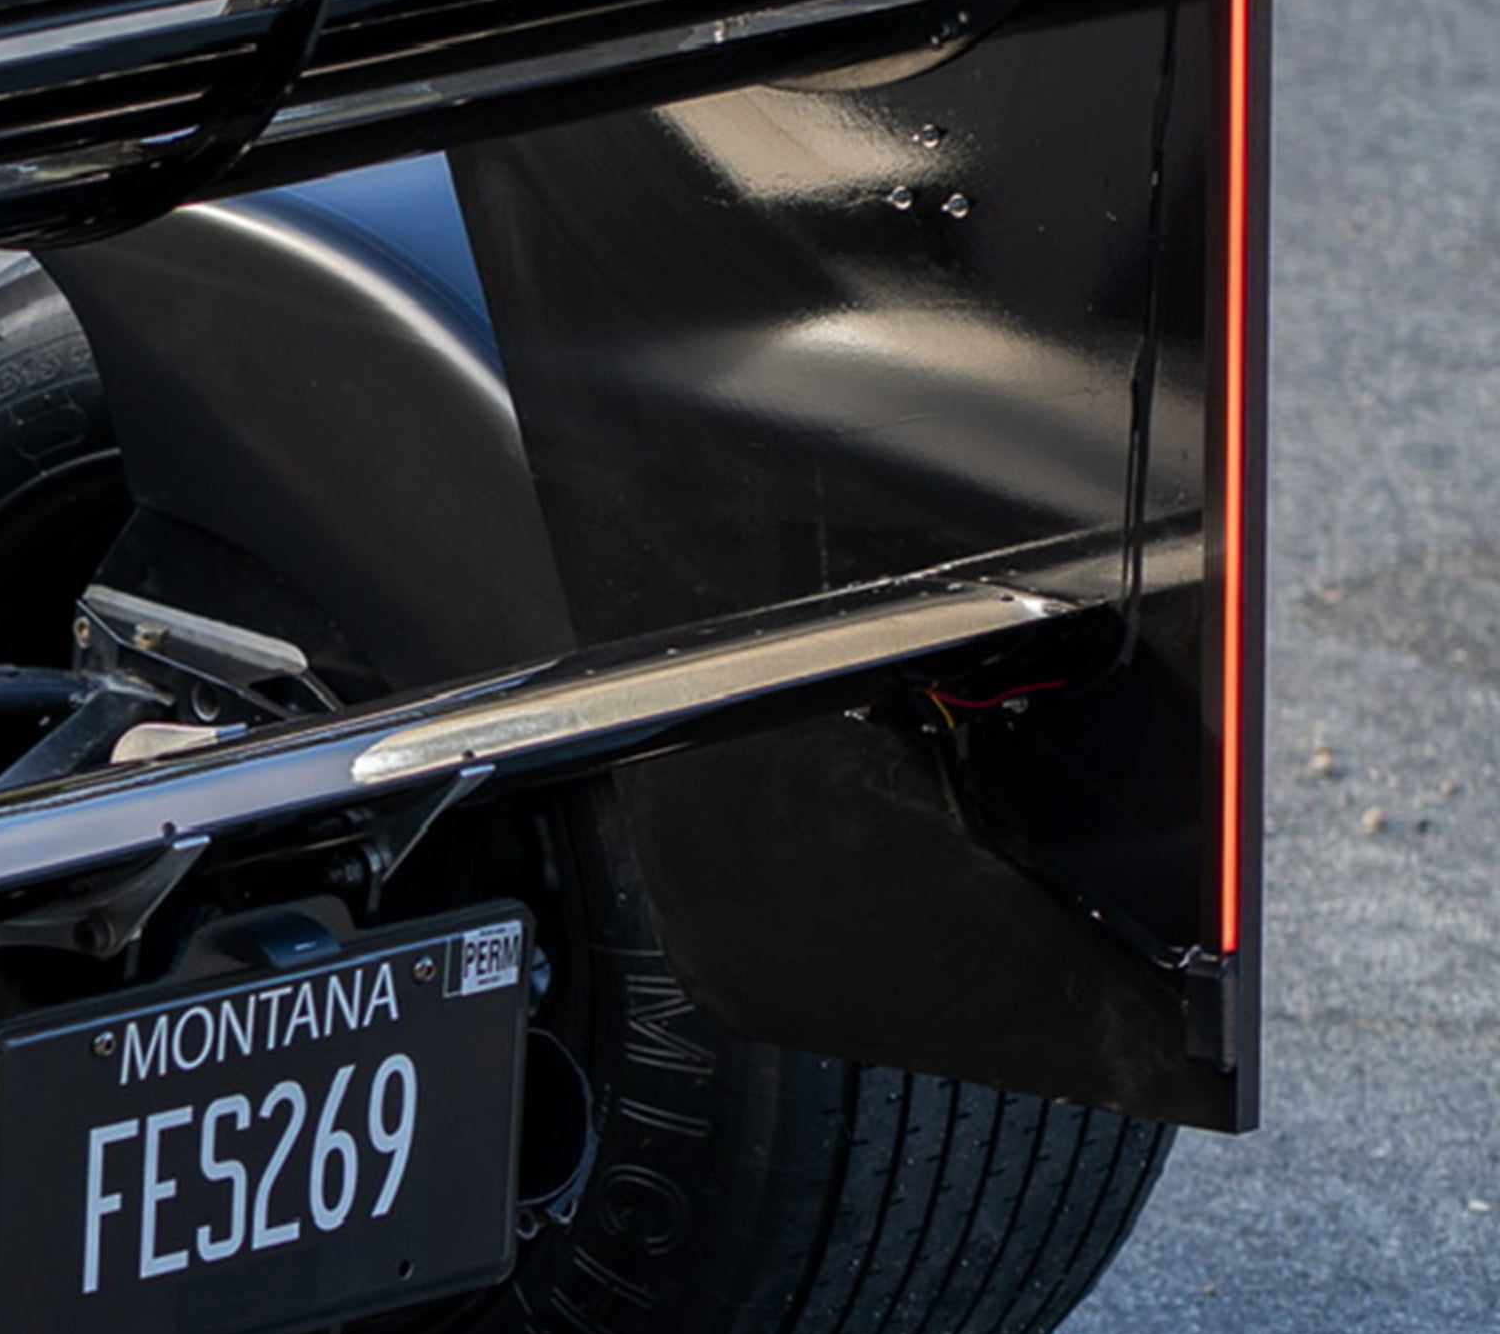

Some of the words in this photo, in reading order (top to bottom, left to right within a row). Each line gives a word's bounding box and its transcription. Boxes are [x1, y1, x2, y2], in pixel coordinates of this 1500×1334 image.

[464, 934, 521, 978] PERM
[119, 963, 400, 1085] MONTANA
[81, 1052, 418, 1294] FES269
